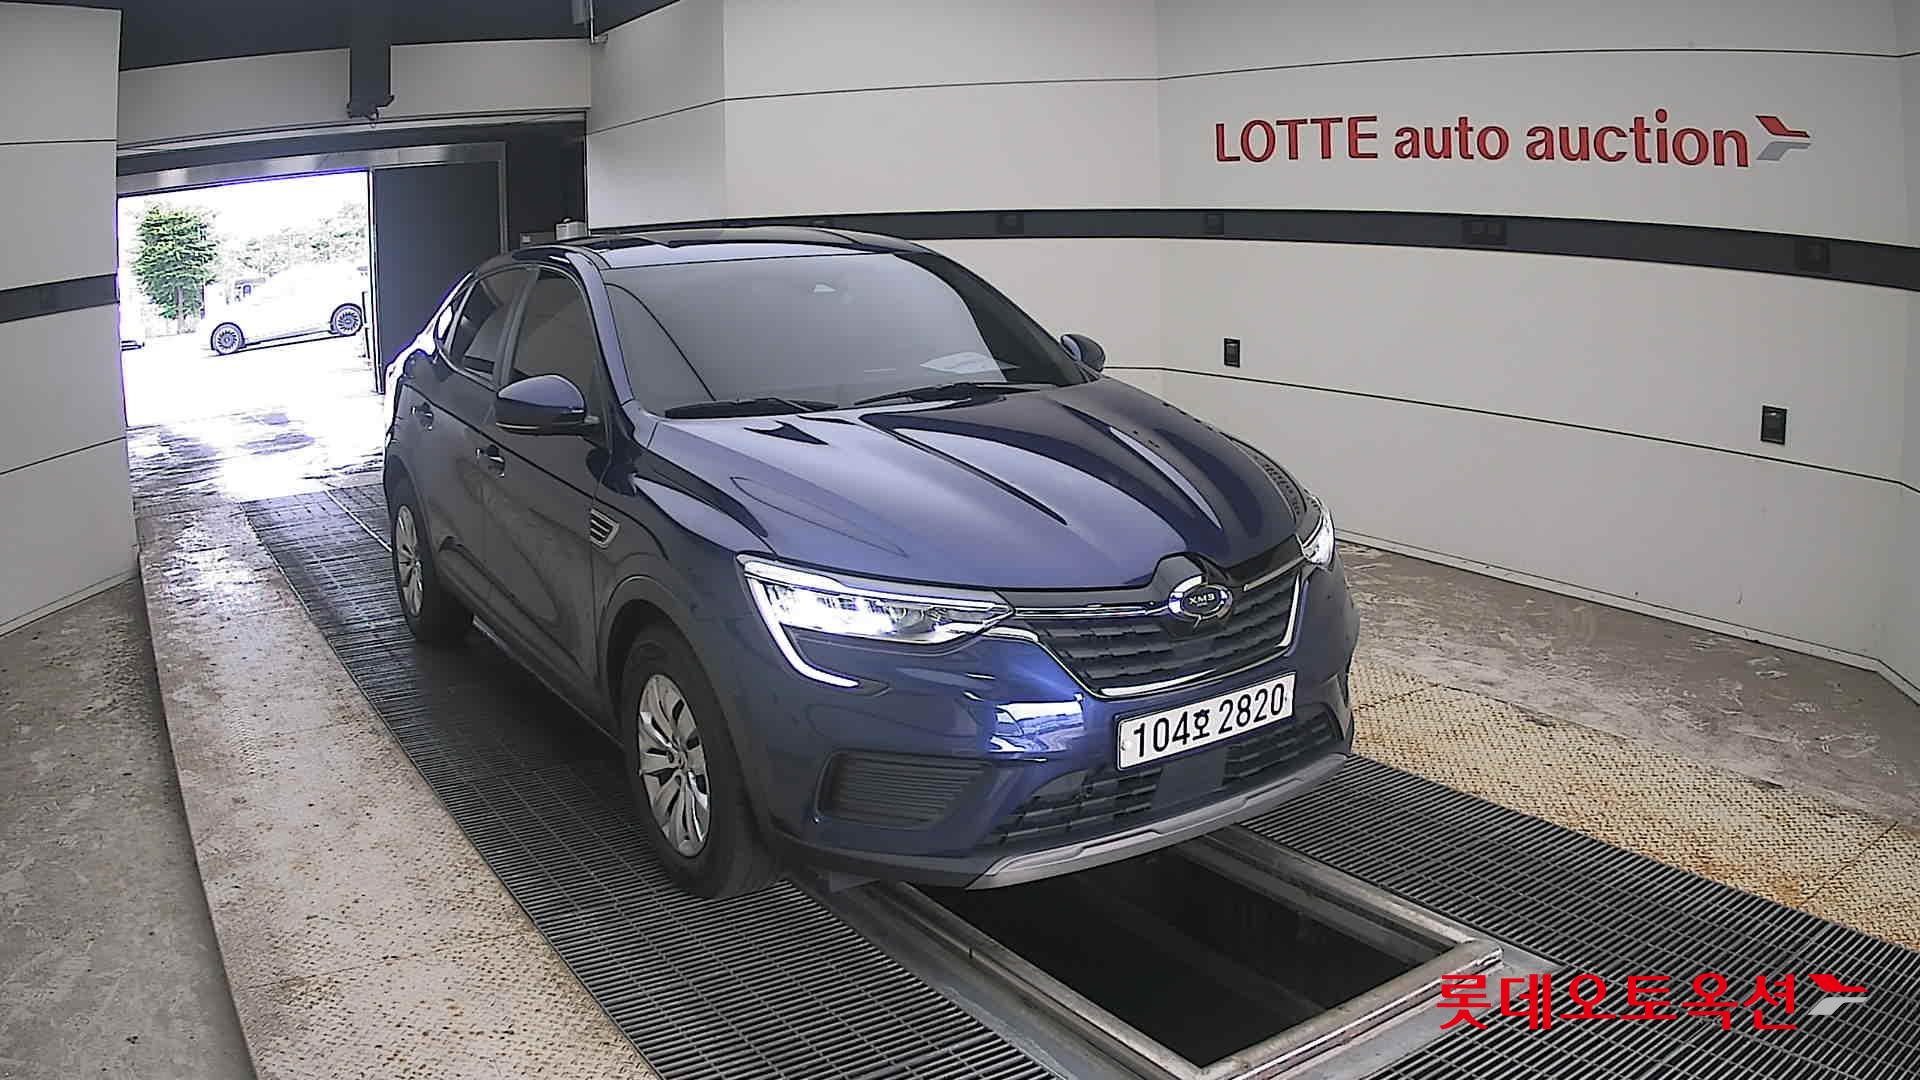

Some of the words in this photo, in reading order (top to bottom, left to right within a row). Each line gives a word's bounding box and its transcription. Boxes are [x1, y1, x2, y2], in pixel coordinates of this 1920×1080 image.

[1215, 115, 1378, 162] LOTTE
[1394, 116, 1509, 160] auto
[1525, 108, 1748, 168] auction
[1133, 708, 1210, 758] 104호
[1218, 683, 1285, 735] 2820
